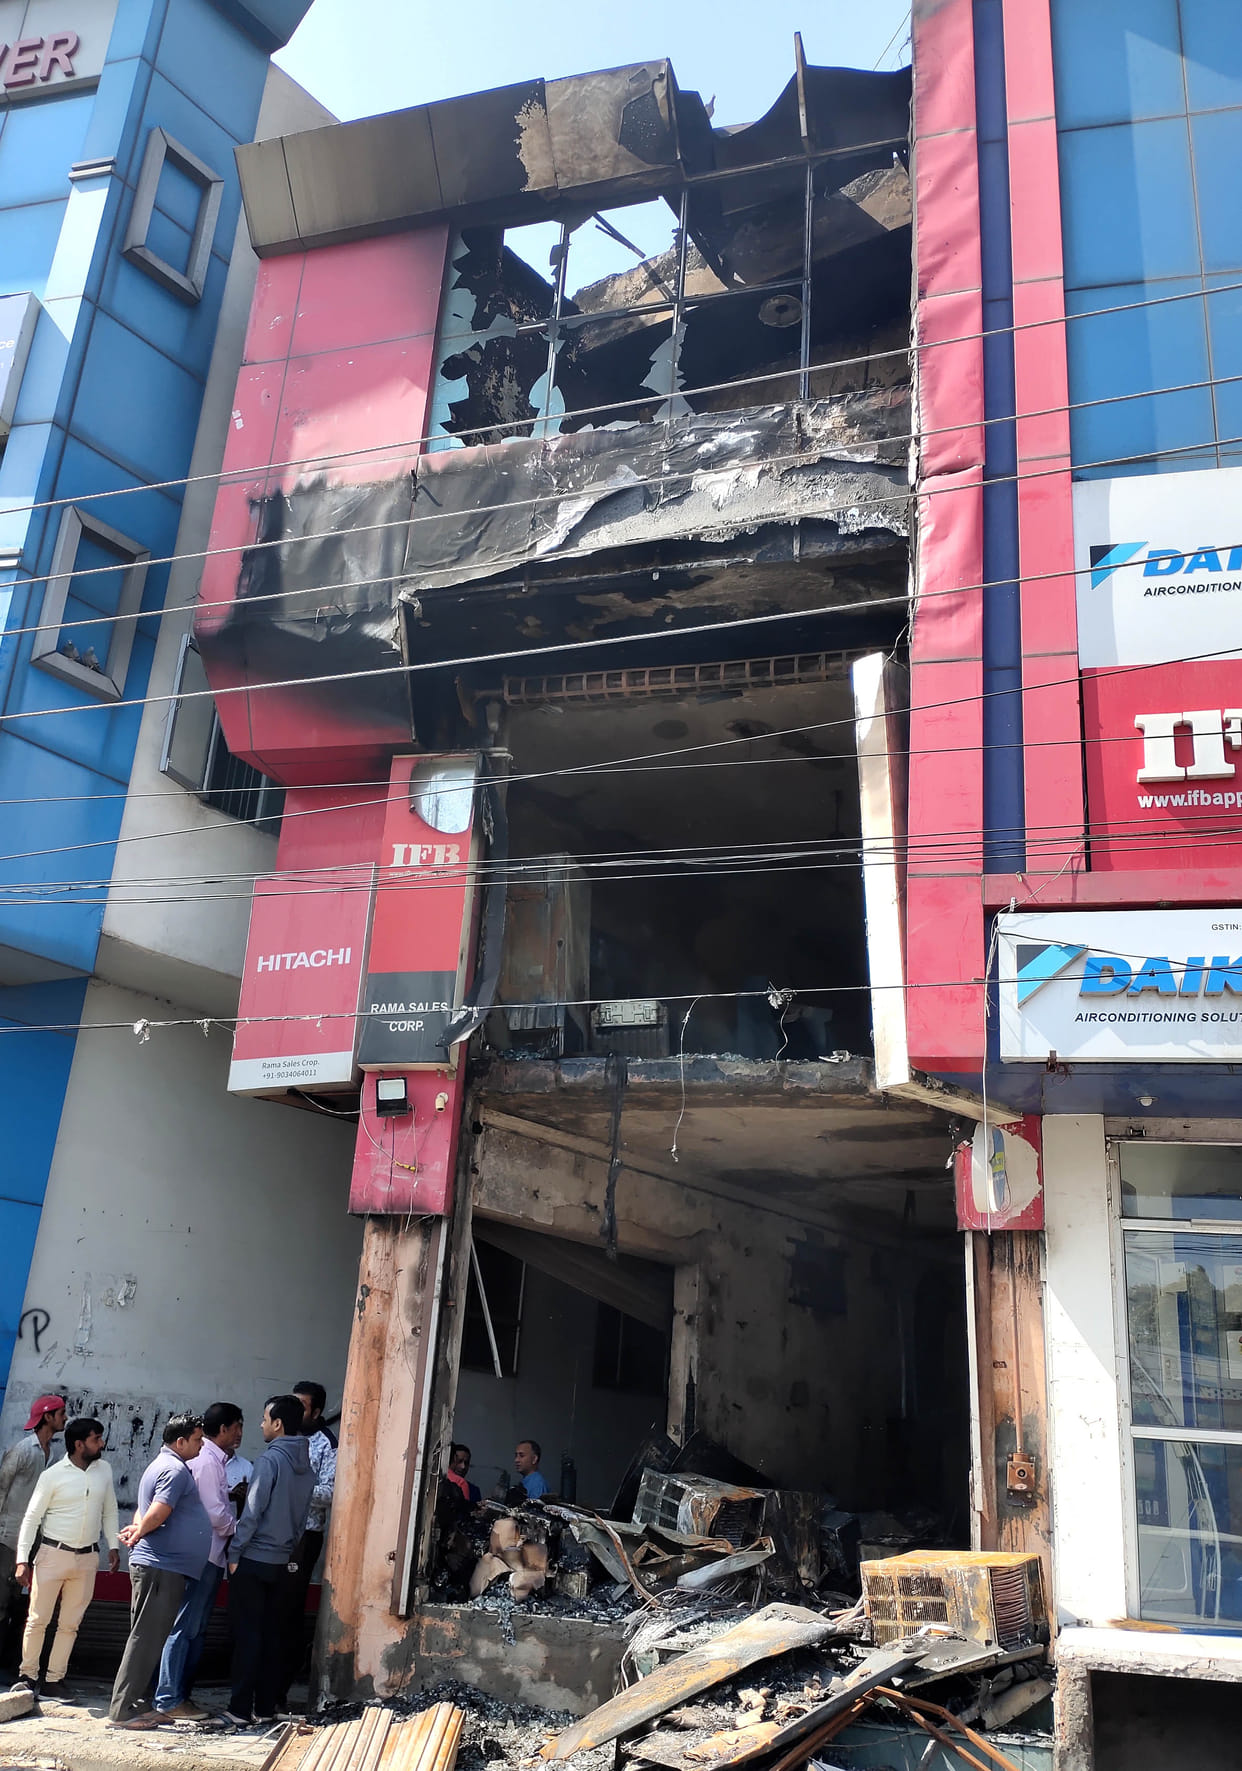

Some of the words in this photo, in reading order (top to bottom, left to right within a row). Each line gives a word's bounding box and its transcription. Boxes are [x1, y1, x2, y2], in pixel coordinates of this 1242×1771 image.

[0, 30, 79, 88] ER
[390, 843, 461, 867] IFB
[256, 947, 352, 973] HITACHI
[370, 1002, 406, 1014] RAMA
[408, 1001, 449, 1013] SALES
[1074, 1012, 1197, 1023] AIRCONDITIONING
[389, 1020, 425, 1032] CORP.
[262, 1062, 281, 1070] Rama
[282, 1060, 301, 1068] Sales
